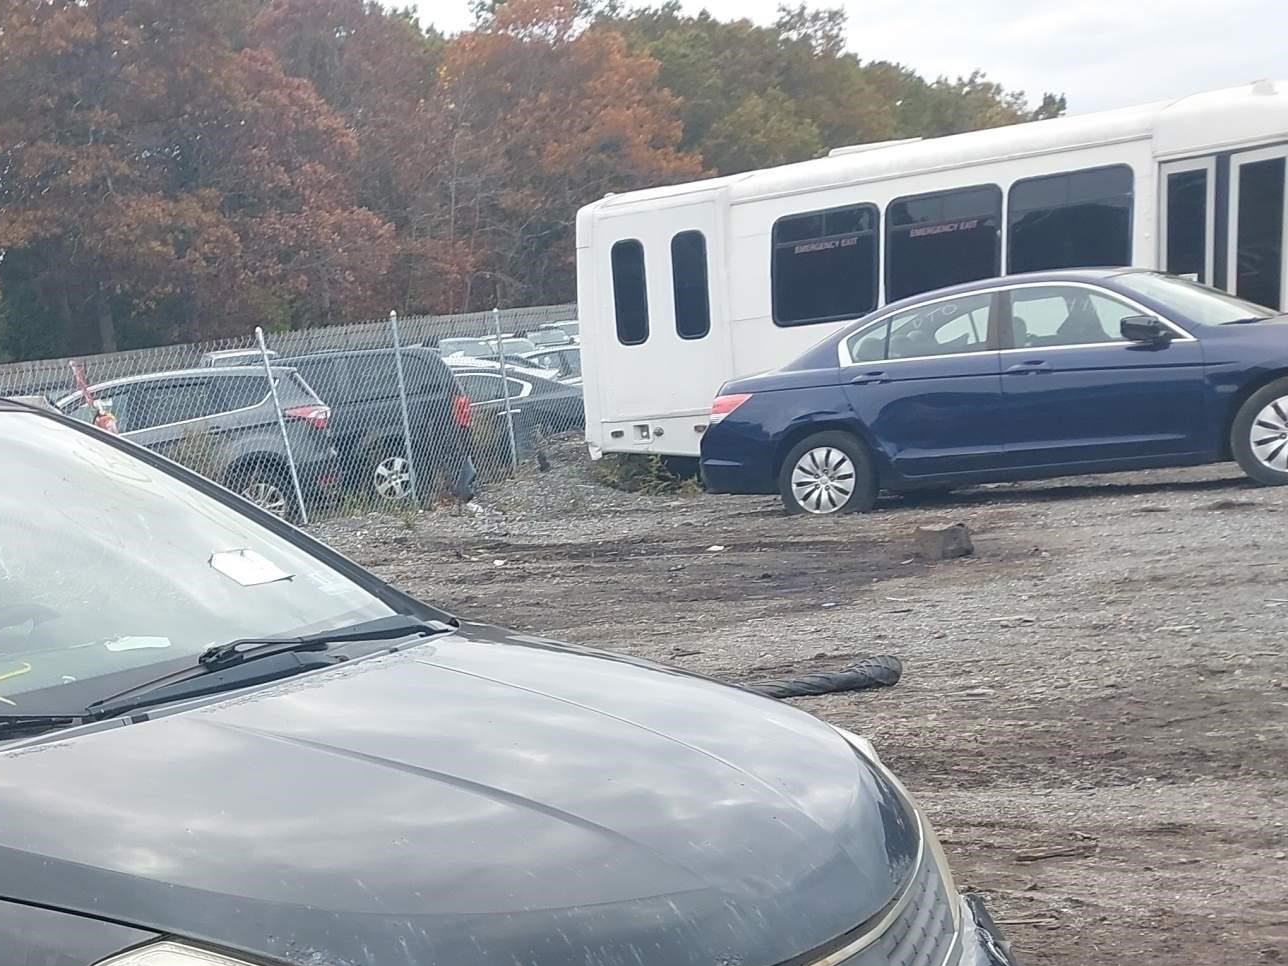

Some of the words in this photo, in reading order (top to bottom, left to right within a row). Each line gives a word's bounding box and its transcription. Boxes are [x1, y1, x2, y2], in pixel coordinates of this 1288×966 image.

[910, 223, 958, 237] EMERGENCY
[959, 220, 978, 231] EXIT
[794, 239, 839, 254] EMERGENCY
[841, 237, 858, 247] EXIT
